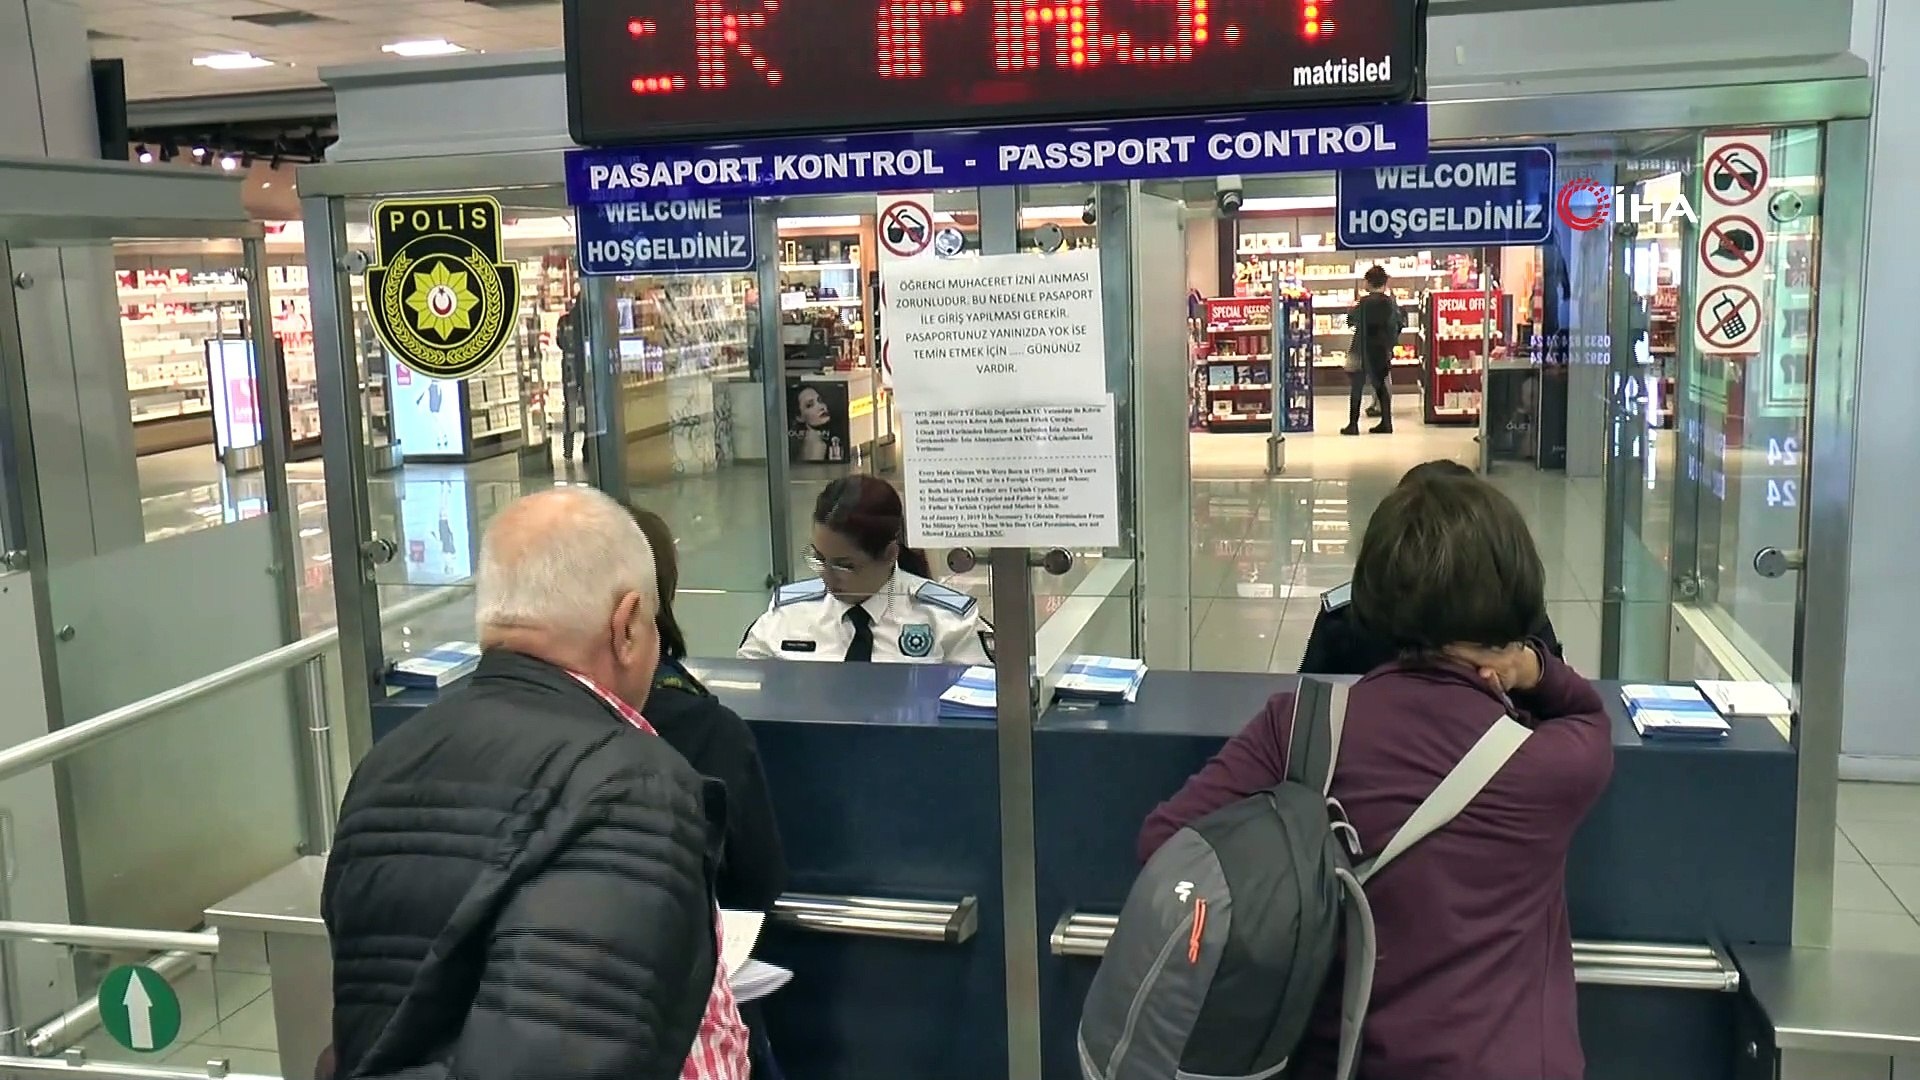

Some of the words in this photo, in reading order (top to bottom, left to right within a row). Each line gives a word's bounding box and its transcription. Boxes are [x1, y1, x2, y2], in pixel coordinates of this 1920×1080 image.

[1293, 56, 1391, 86] matrisled
[590, 156, 763, 190] PASAPORT
[774, 149, 944, 182] KONTROL
[998, 135, 1195, 171] PASSPORT
[1207, 124, 1397, 161] CONTROL
[1375, 162, 1517, 189] WELCOME
[389, 202, 487, 232] POLİS
[605, 200, 722, 224] WELCOME
[1348, 199, 1543, 238] HOŞGELDİNİZ
[587, 231, 747, 267] HOŞGELDİNİZ
[900, 279, 946, 292] ÖĞRENCİ
[949, 276, 1012, 289] MUHACERET
[1015, 276, 1036, 285] İZNİ
[1039, 272, 1089, 284] ALINMASI
[896, 297, 970, 308] ZORUNLUDUR.
[972, 295, 987, 305] BU
[990, 293, 1036, 304] NEDENLE
[1039, 290, 1093, 300] PASAPORT
[1438, 298, 1467, 311] SPECIAL
[921, 315, 934, 325] İLE
[938, 313, 964, 325] GİRİŞ
[967, 311, 1021, 322] YAPILMASI
[1024, 308, 1069, 320] GEREKİR.
[1212, 304, 1241, 318] SPECIAL
[906, 329, 987, 342] PASAPORTUNUZ
[990, 328, 1046, 339] YANINIZDA
[1050, 326, 1069, 336] YOK
[1072, 325, 1086, 335] İSE
[914, 348, 946, 359] TEMİN
[949, 346, 984, 357] ETMEK
[986, 344, 1007, 357] İÇİN
[1027, 343, 1081, 355] GÜNÜNÜZ
[976, 364, 1017, 374] VARDIR.
